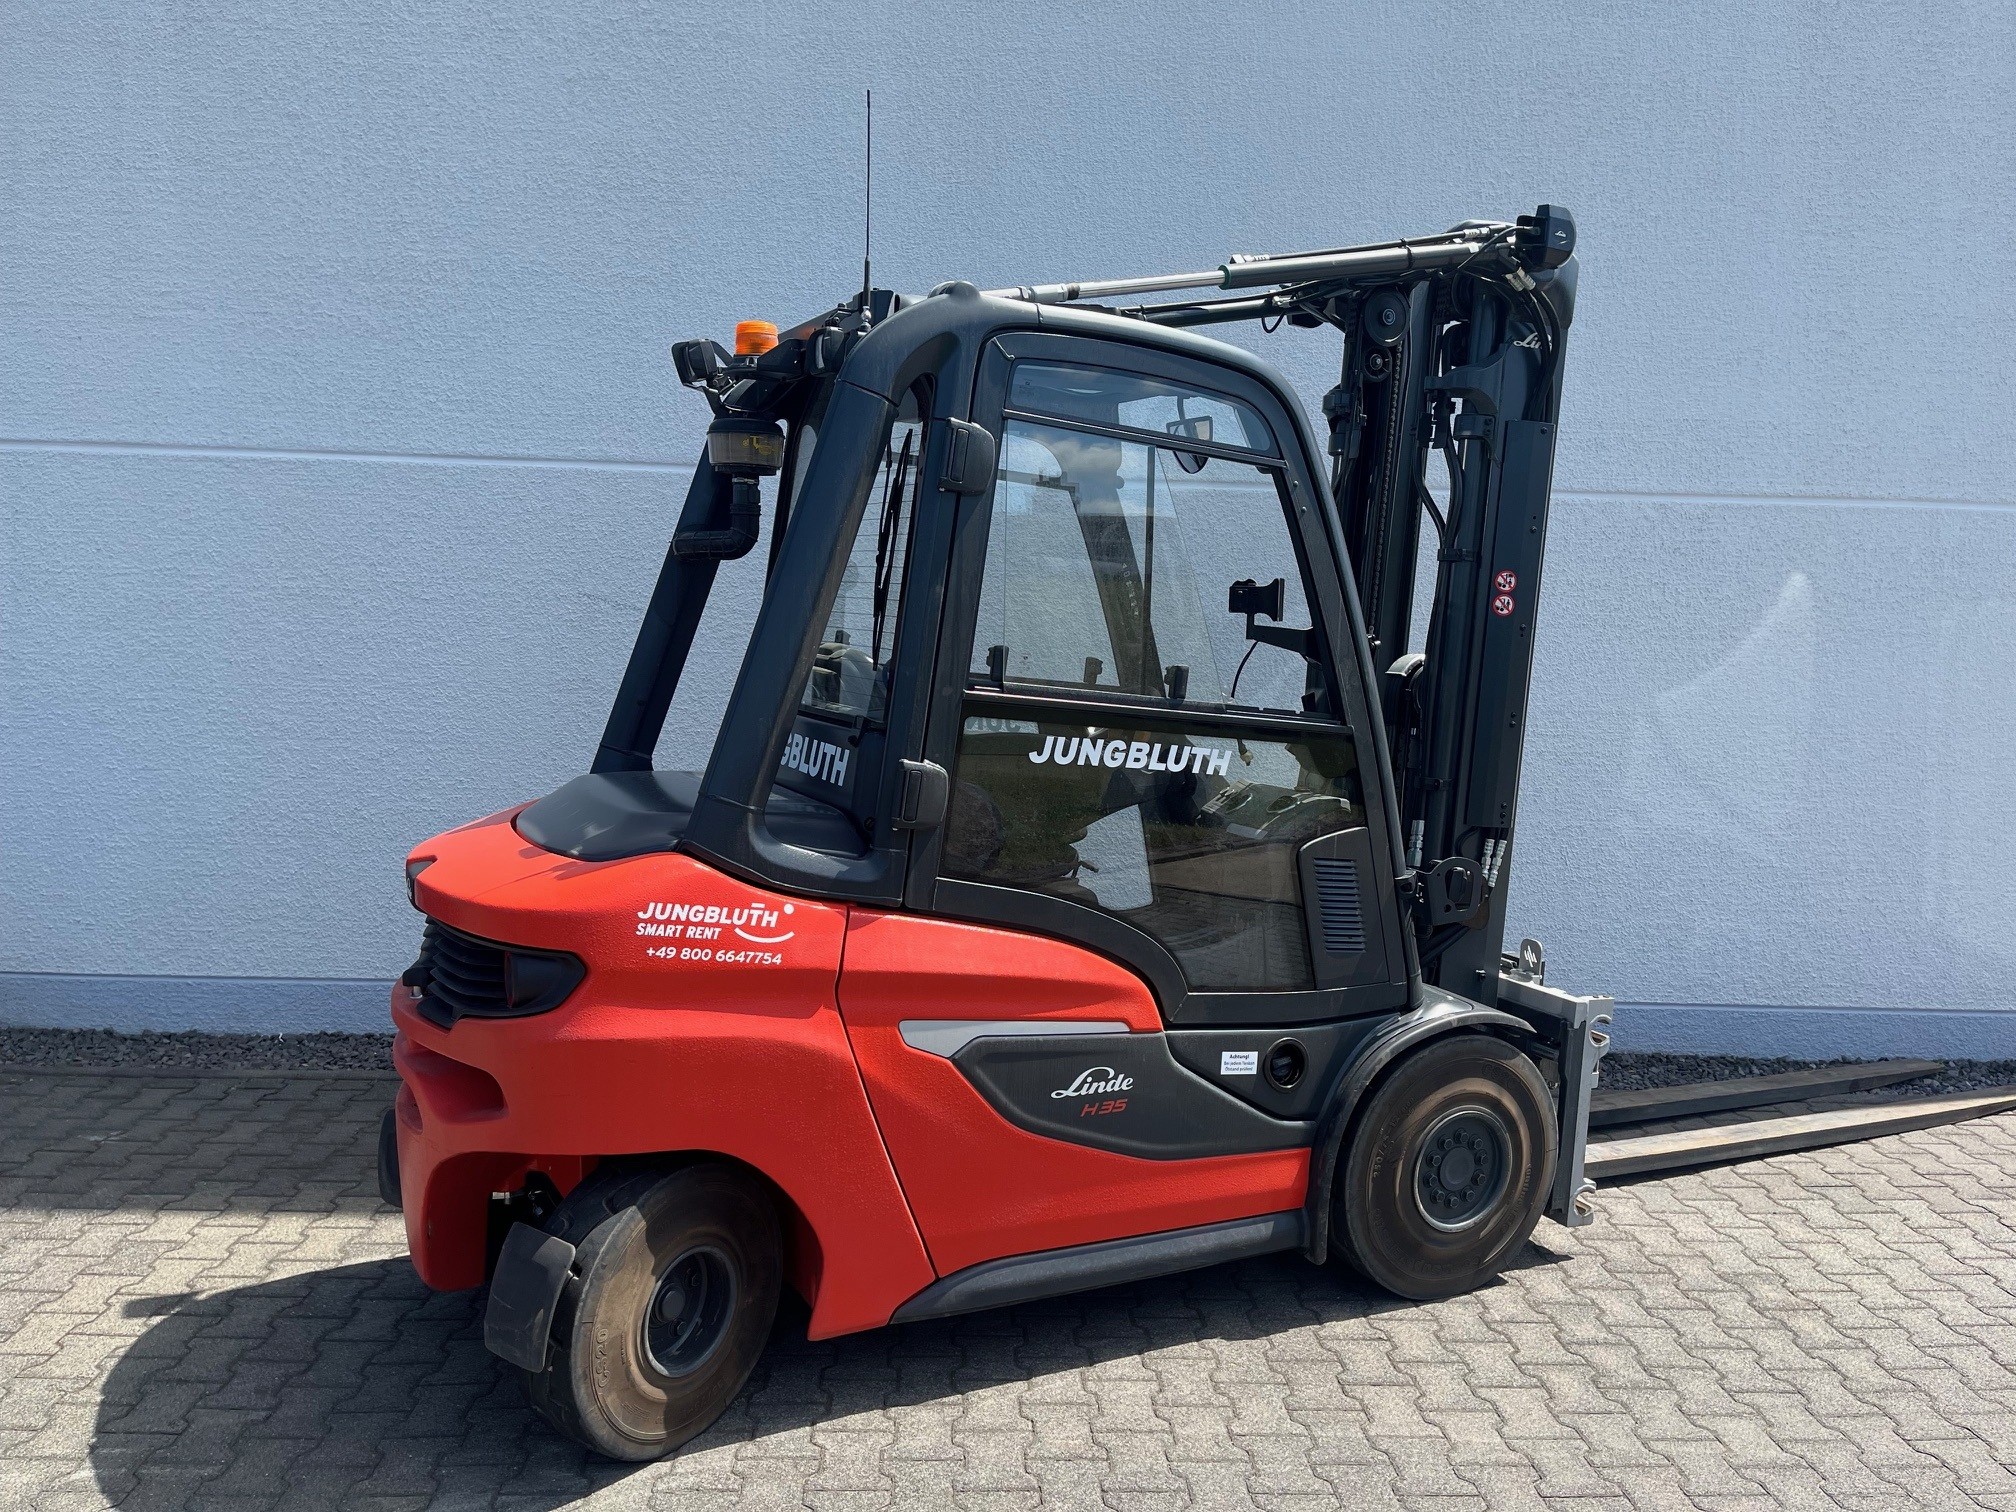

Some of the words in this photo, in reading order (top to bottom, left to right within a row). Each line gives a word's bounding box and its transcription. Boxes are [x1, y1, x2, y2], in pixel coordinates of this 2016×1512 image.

[1028, 735, 1233, 776] JUNGBLUTH
[636, 901, 779, 928] JUNGBLUTH
[636, 923, 685, 938] SMART
[686, 926, 723, 940] RENT
[646, 946, 677, 959] +49
[680, 947, 712, 961] 800
[715, 950, 783, 965] 6647754
[1051, 1066, 1134, 1099] Linde
[1080, 1102, 1099, 1117] H
[1099, 1099, 1128, 1115] 35
